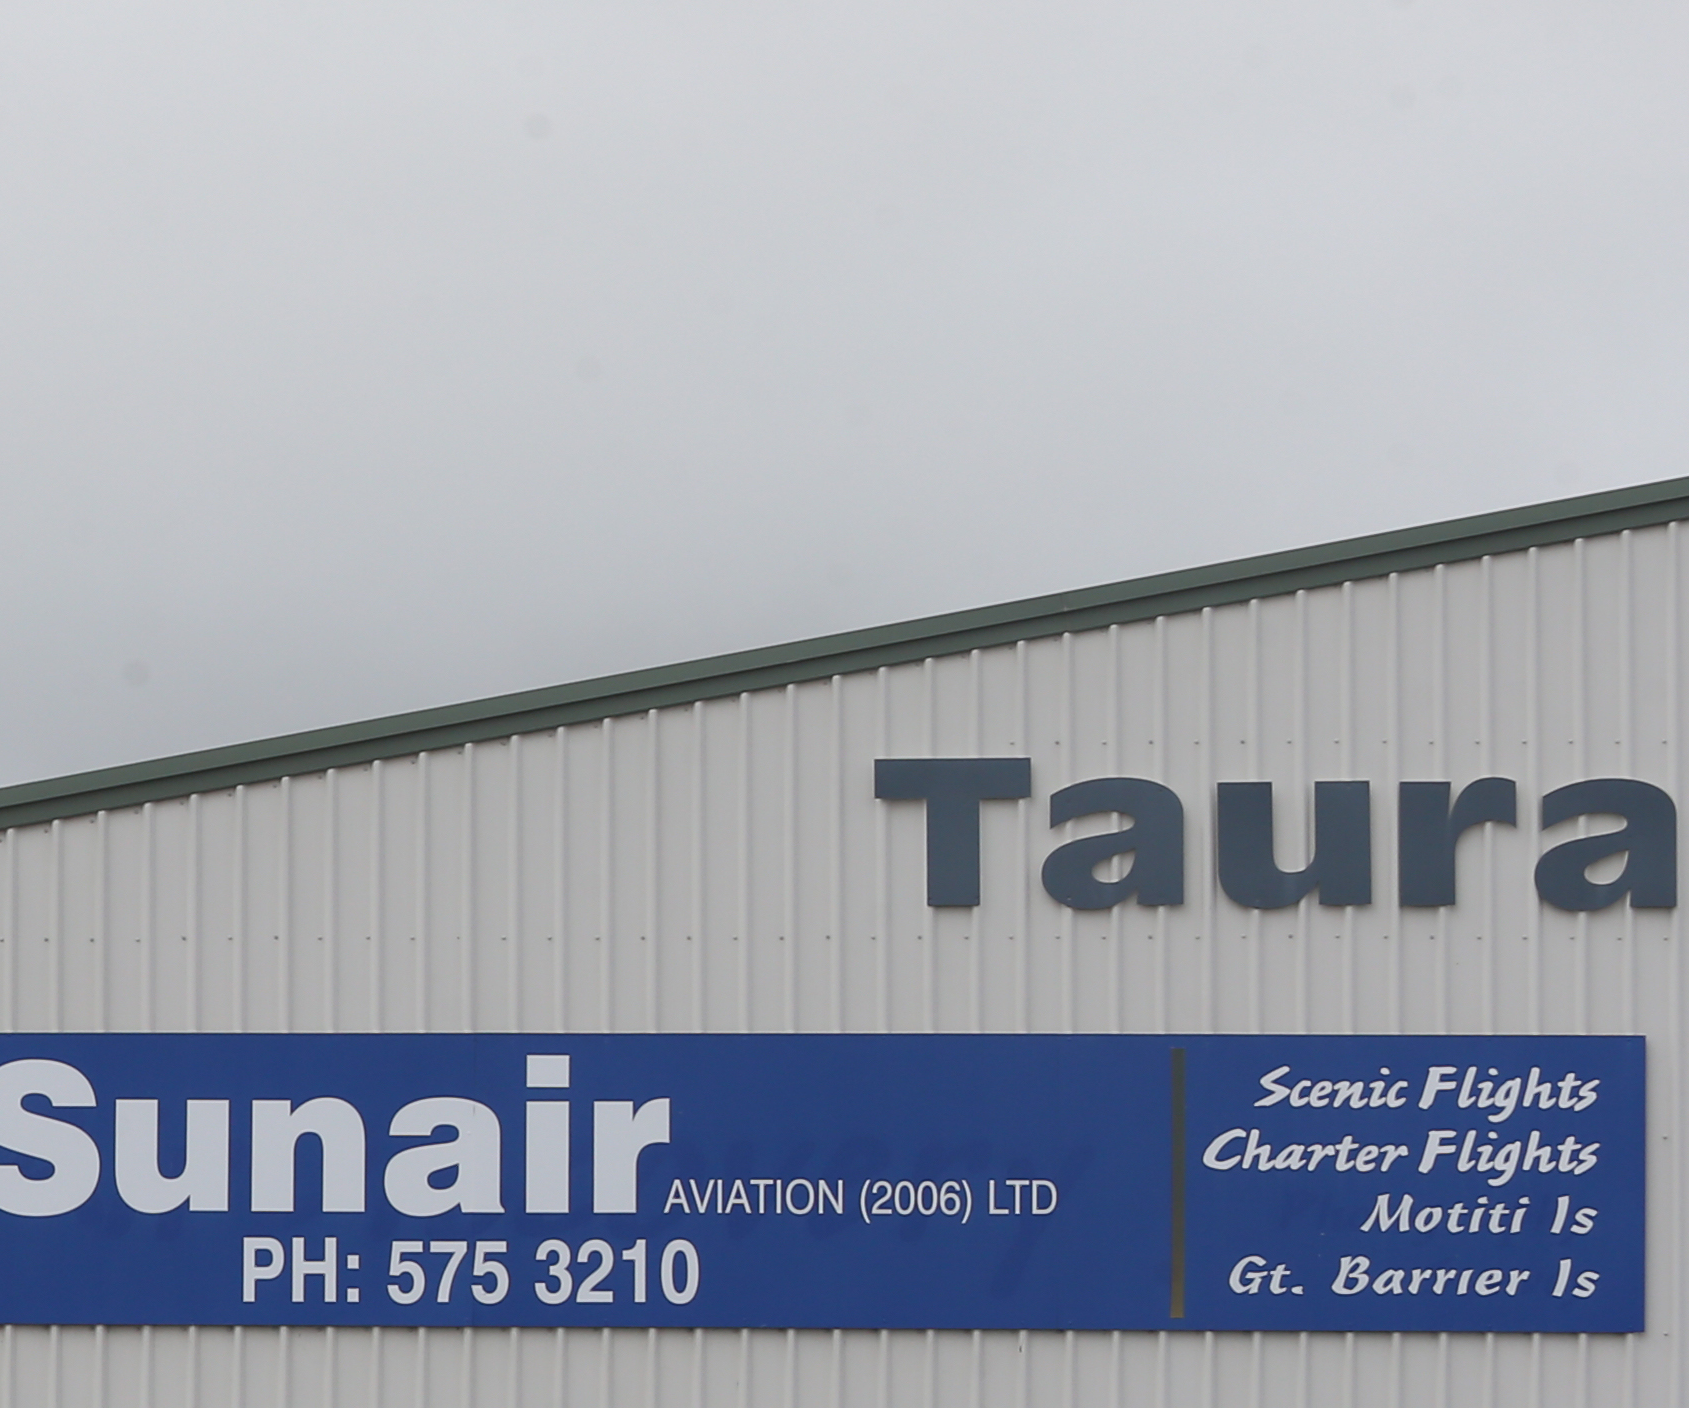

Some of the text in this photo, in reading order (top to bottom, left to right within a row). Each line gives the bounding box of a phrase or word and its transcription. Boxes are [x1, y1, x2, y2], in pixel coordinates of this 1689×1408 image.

[874, 758, 1677, 916] Taura
[1253, 1065, 1600, 1123] Scenic Flights
[1202, 1128, 1600, 1187] Charter Flights
[664, 1180, 842, 1214] AVIATION
[861, 1179, 971, 1223] (2006)
[989, 1180, 1057, 1214] LTD
[1360, 1194, 1598, 1234] Motiti Is
[243, 1238, 698, 1304] PH: 575 3210
[1228, 1255, 1600, 1298] Gt. Barrier Is
